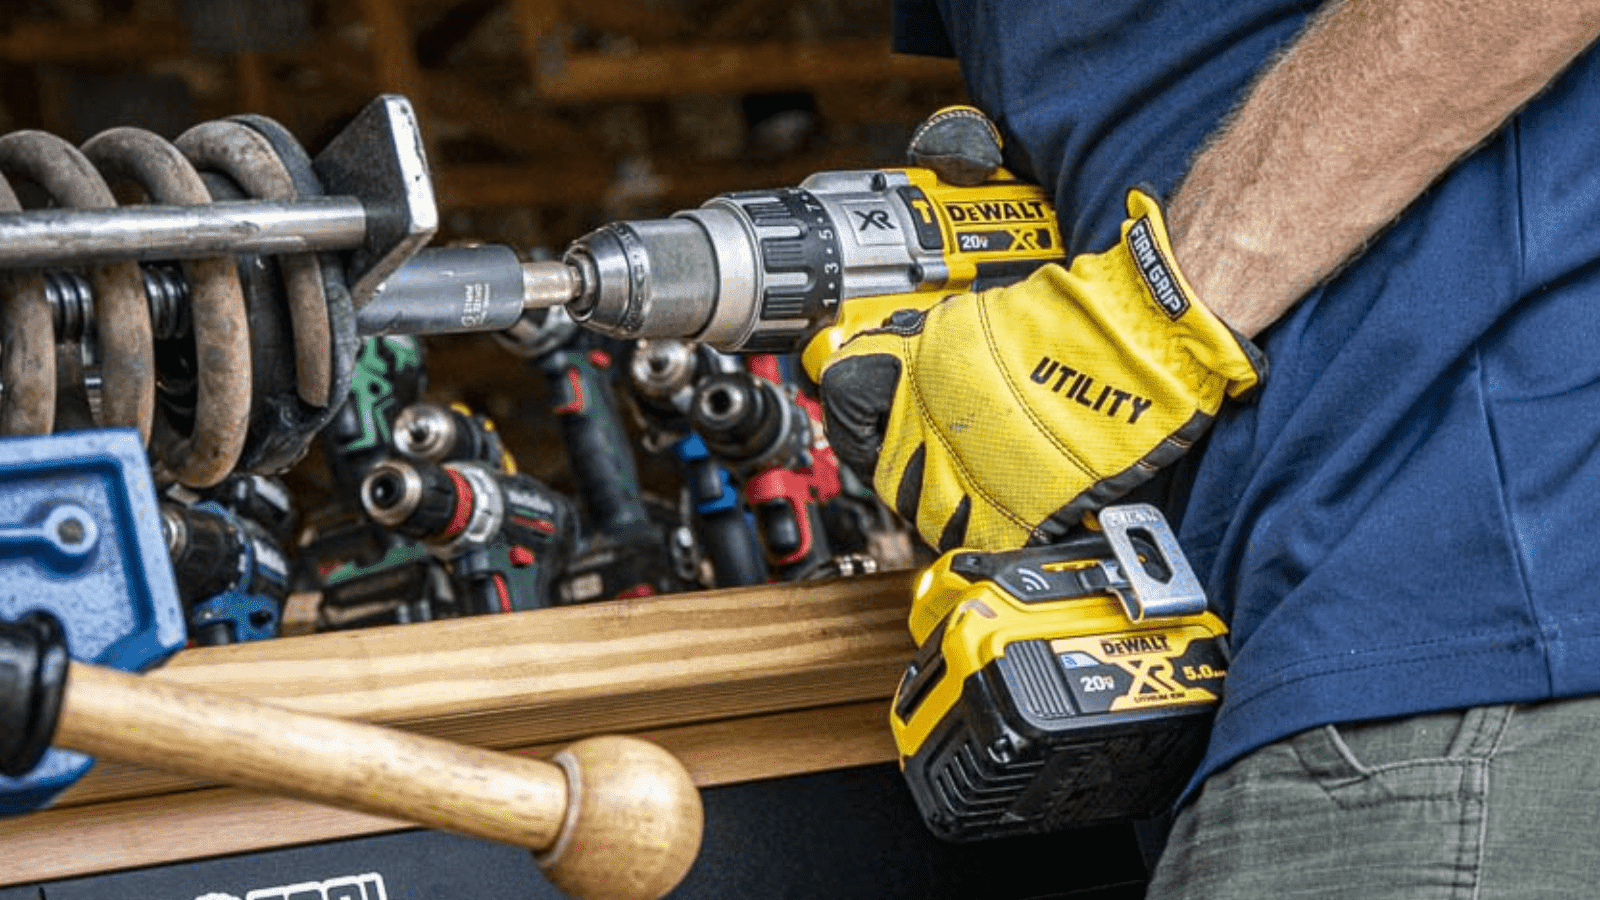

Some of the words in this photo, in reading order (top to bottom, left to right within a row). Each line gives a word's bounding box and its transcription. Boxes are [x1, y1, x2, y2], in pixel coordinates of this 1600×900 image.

[853, 210, 896, 231] XR
[818, 229, 833, 240] 5
[824, 262, 839, 275] 3
[1130, 224, 1157, 269] FIRM
[1148, 264, 1182, 312] GRIP
[822, 298, 838, 308] 1
[1030, 356, 1152, 424] UTILITY
